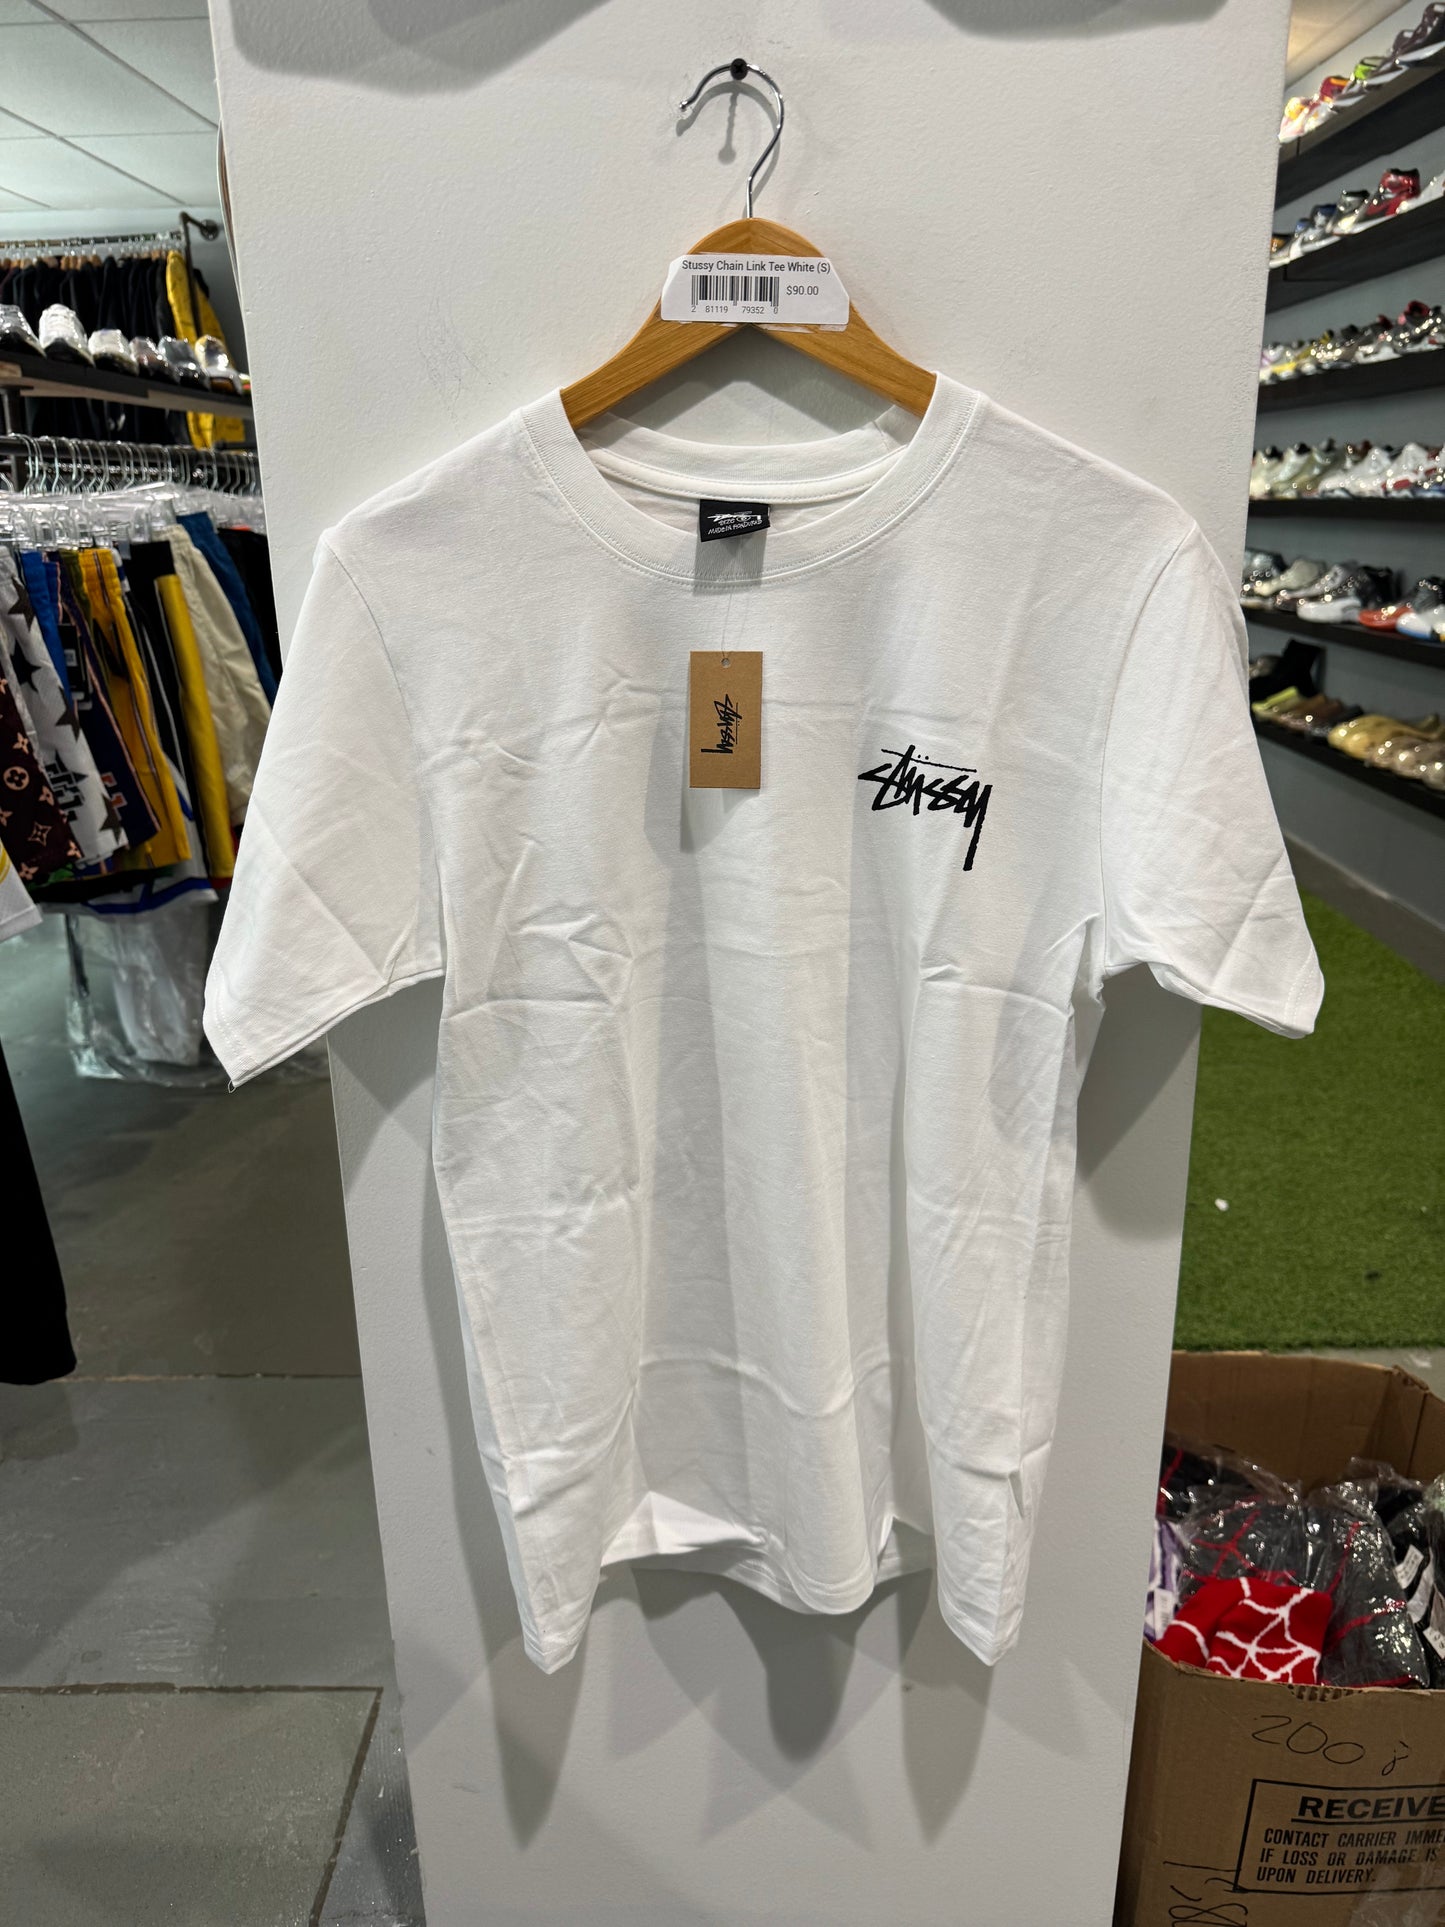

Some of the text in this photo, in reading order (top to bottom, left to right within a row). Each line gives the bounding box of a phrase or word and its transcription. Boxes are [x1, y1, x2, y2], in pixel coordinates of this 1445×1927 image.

[682, 260, 831, 274] Stussy Chain Link Tee White (S)
[786, 286, 819, 296] $90.00
[705, 306, 729, 314] 81119
[742, 306, 765, 314] 79352
[773, 307, 779, 315] 0
[1252, 1715, 1366, 1764] 200
[1263, 1828, 1445, 1848] CONTACT CARRIER IMME
[1260, 1848, 1275, 1862] IF
[1282, 1849, 1318, 1866] LOSS
[1327, 1852, 1346, 1866] OR
[1355, 1848, 1418, 1865] DAMAGE
[1256, 1867, 1376, 1884] UPON DELIVERY.
